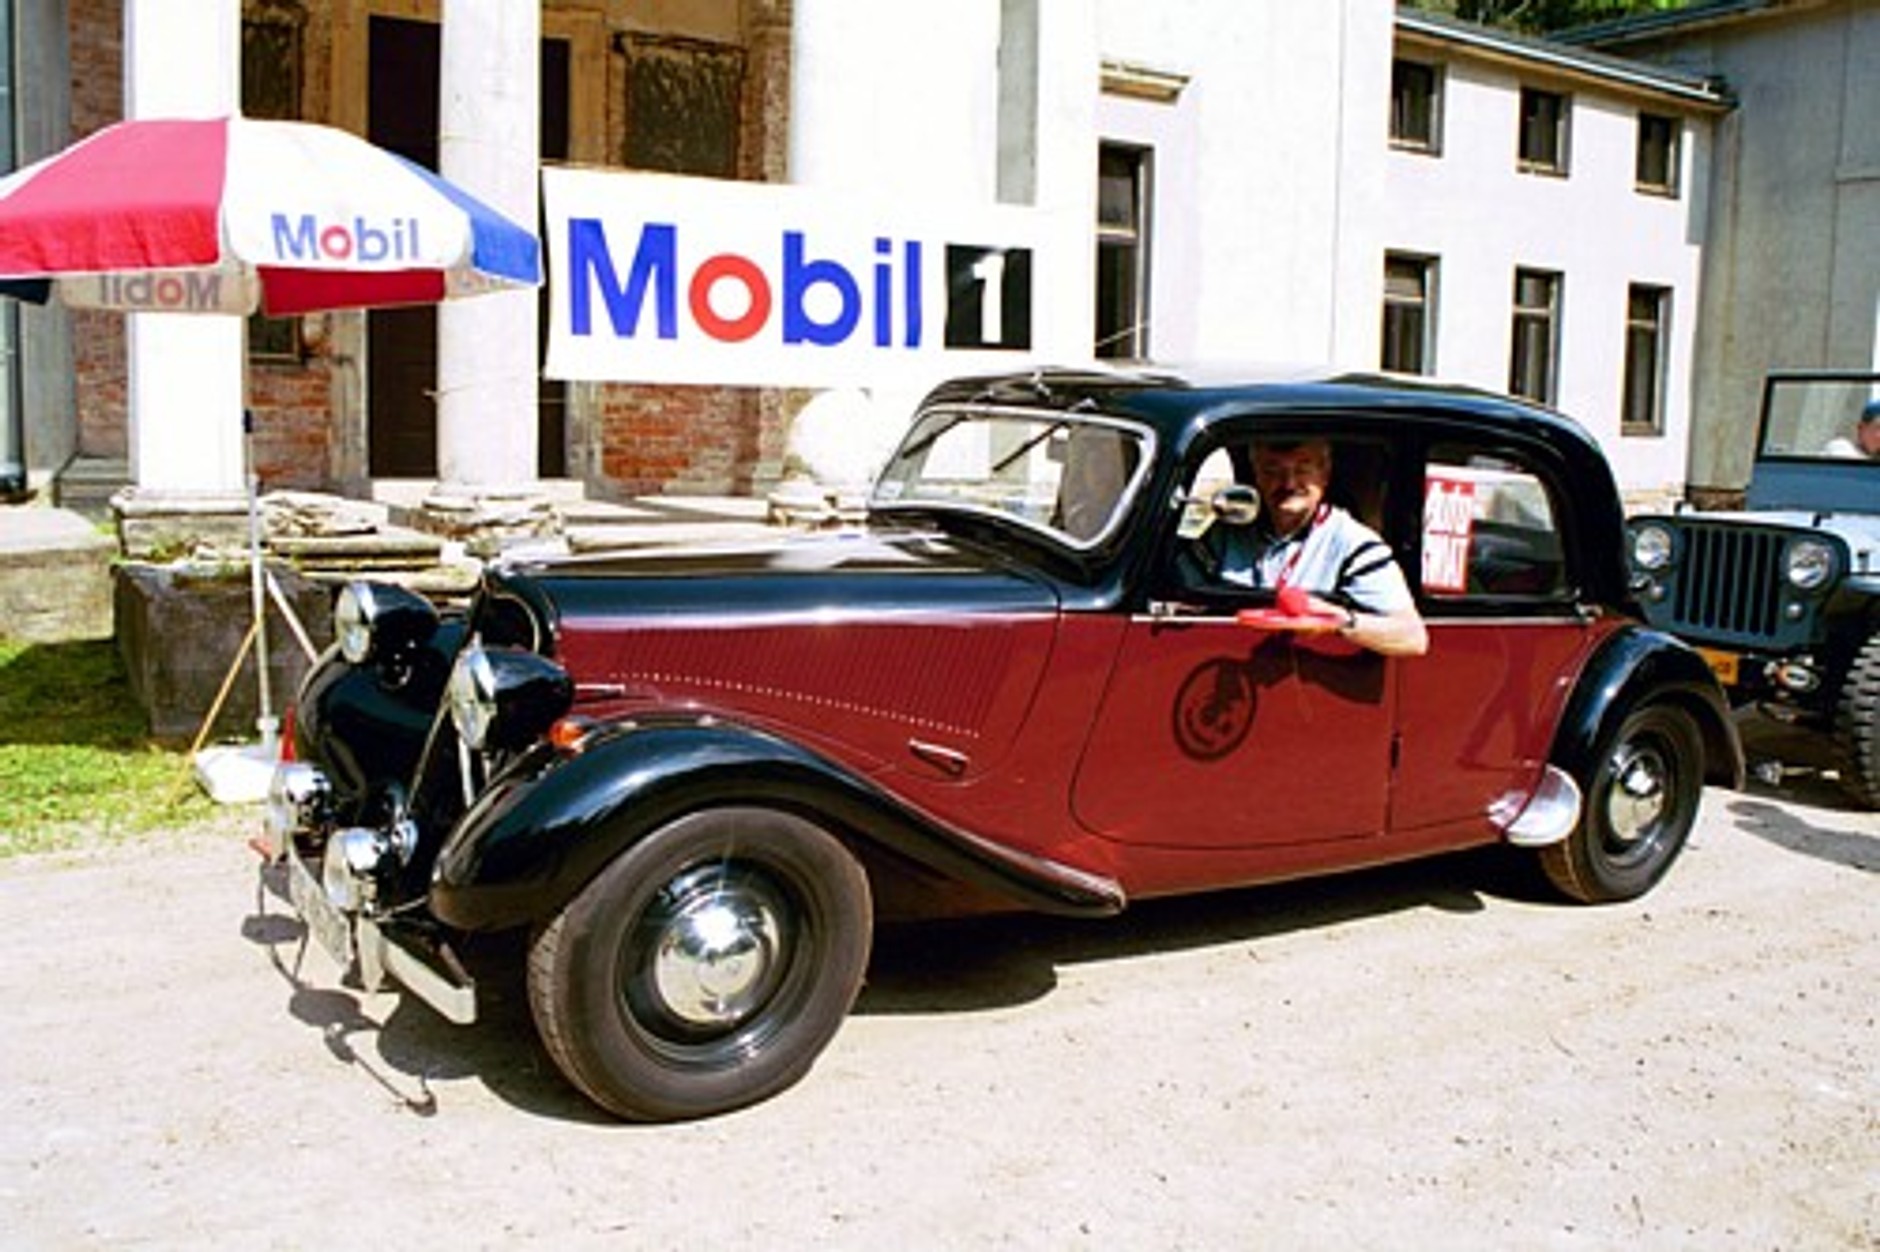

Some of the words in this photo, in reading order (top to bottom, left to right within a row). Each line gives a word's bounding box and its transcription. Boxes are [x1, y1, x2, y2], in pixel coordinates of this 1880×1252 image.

[271, 213, 419, 261] Mobil
[567, 217, 922, 348] Mobil
[973, 253, 1006, 344] 1
